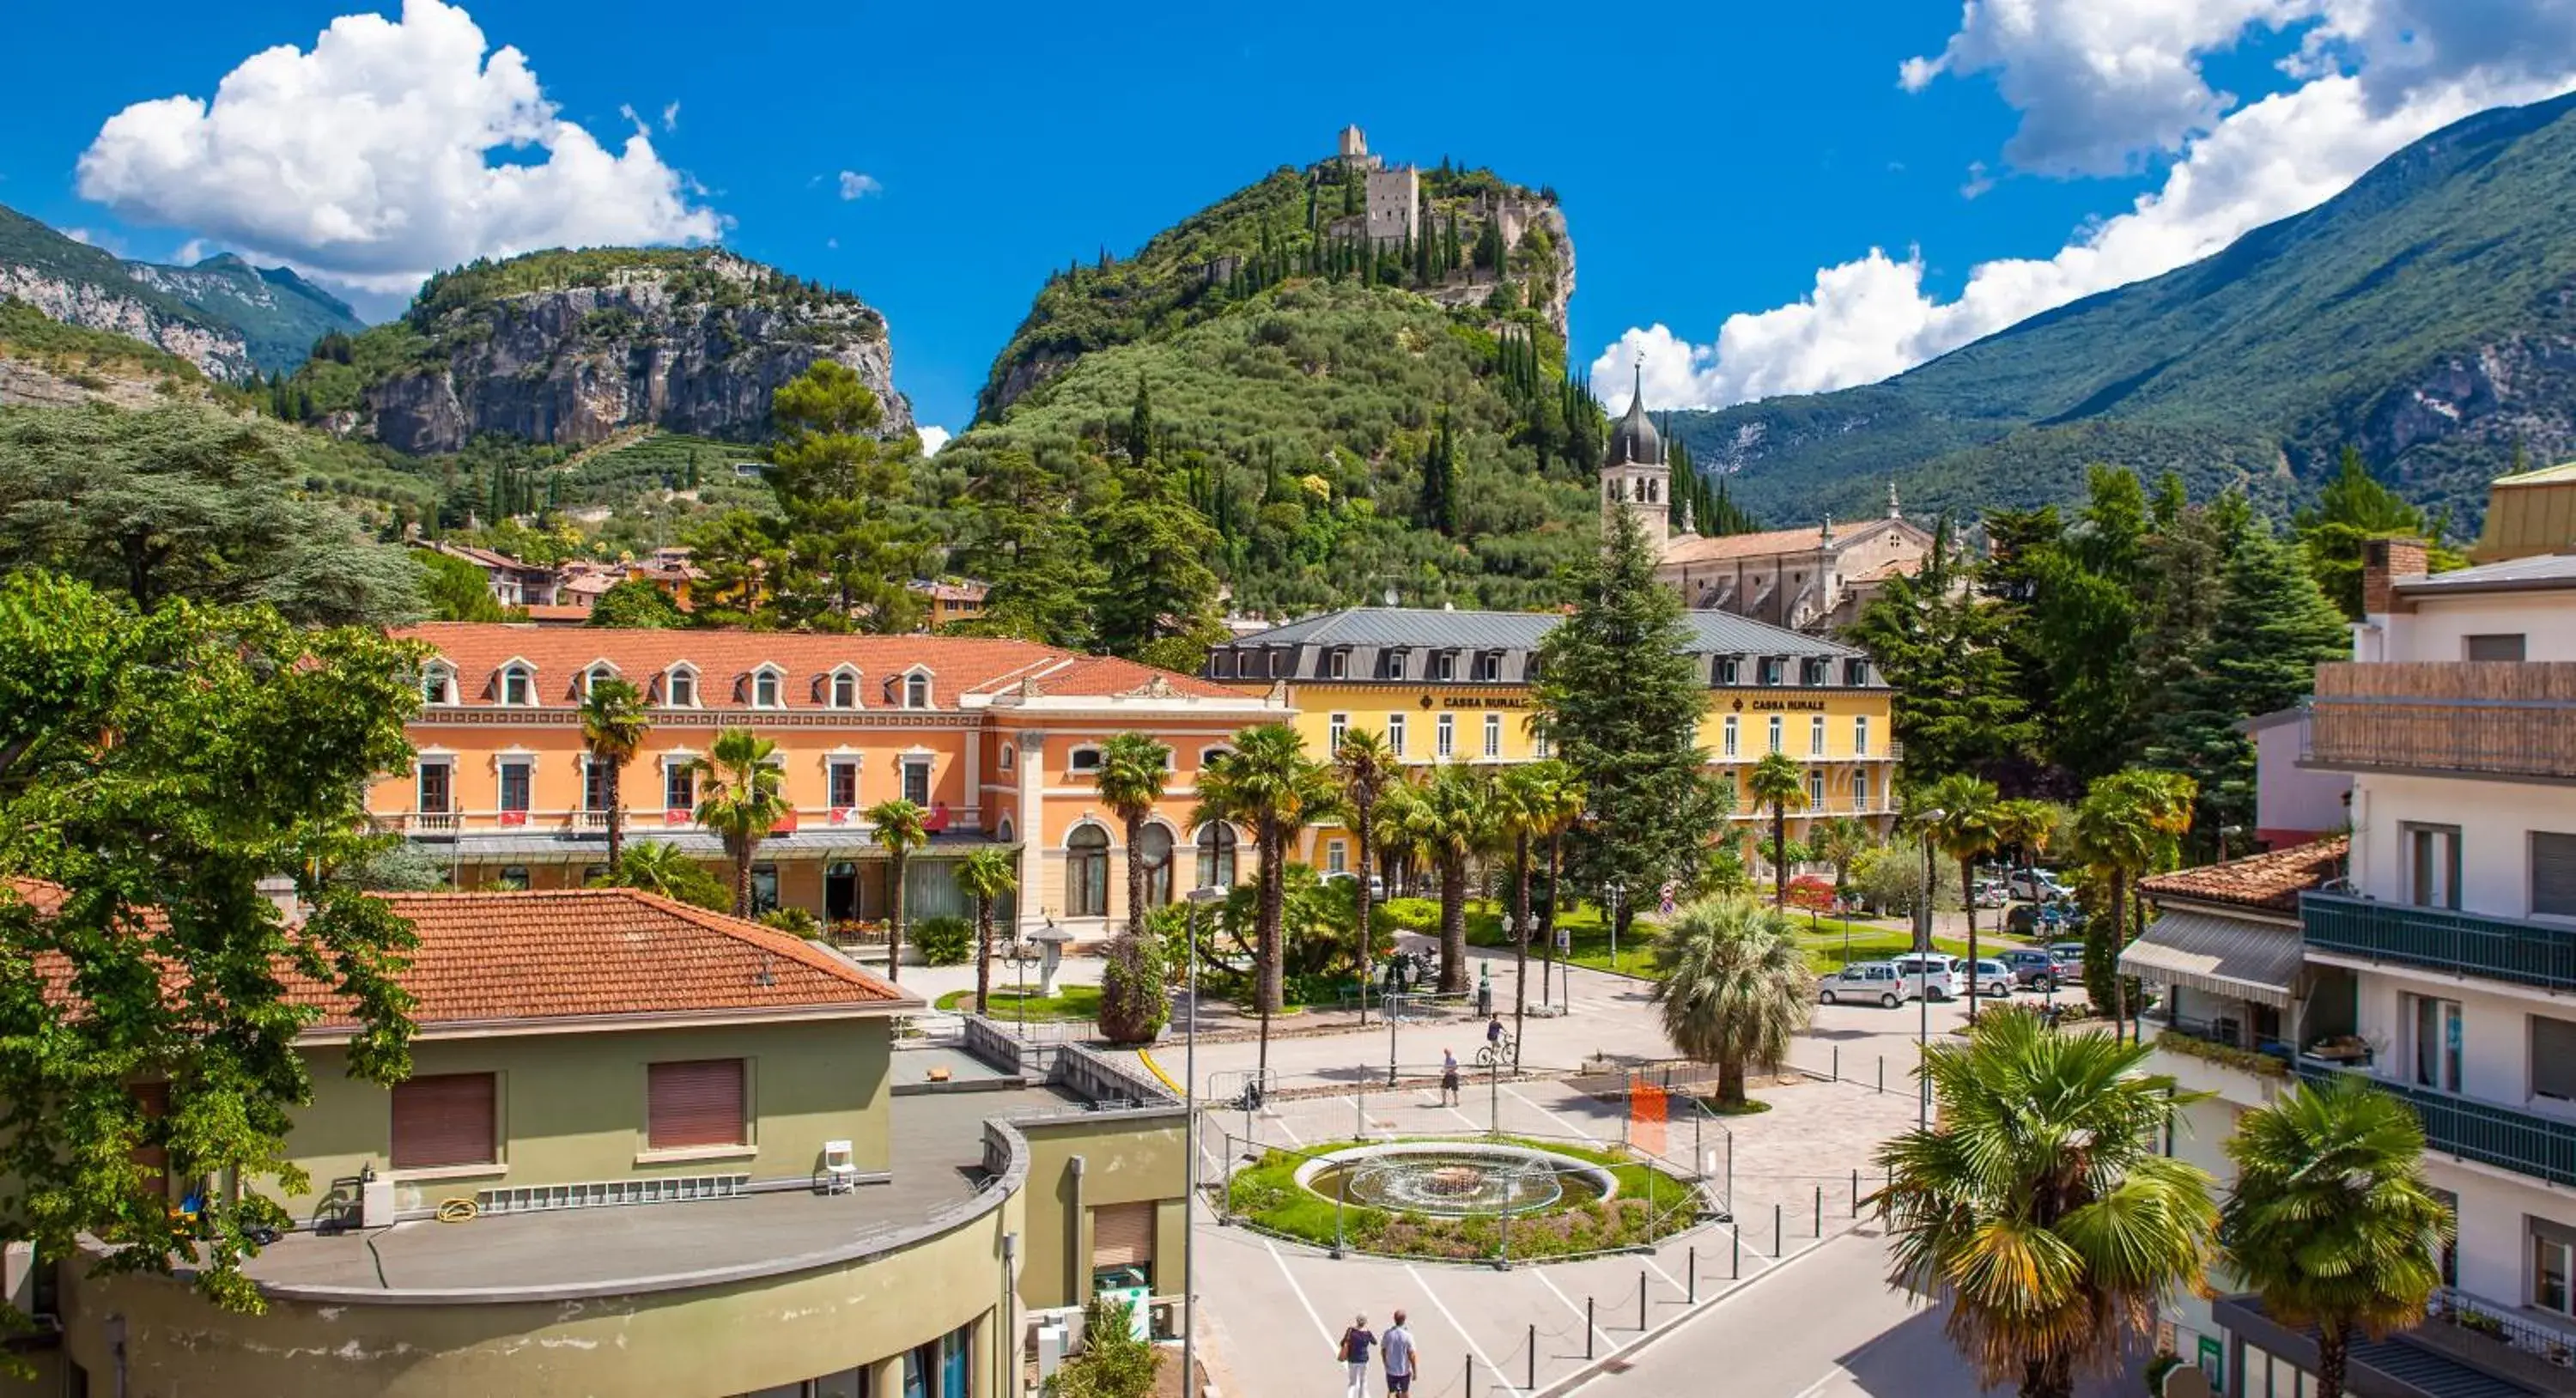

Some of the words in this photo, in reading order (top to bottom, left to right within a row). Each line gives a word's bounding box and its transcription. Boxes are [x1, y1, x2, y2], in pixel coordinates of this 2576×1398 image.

[1443, 697, 1481, 708] CASSA
[1753, 700, 1785, 710] CASSA
[1787, 700, 1825, 710] RURALE
